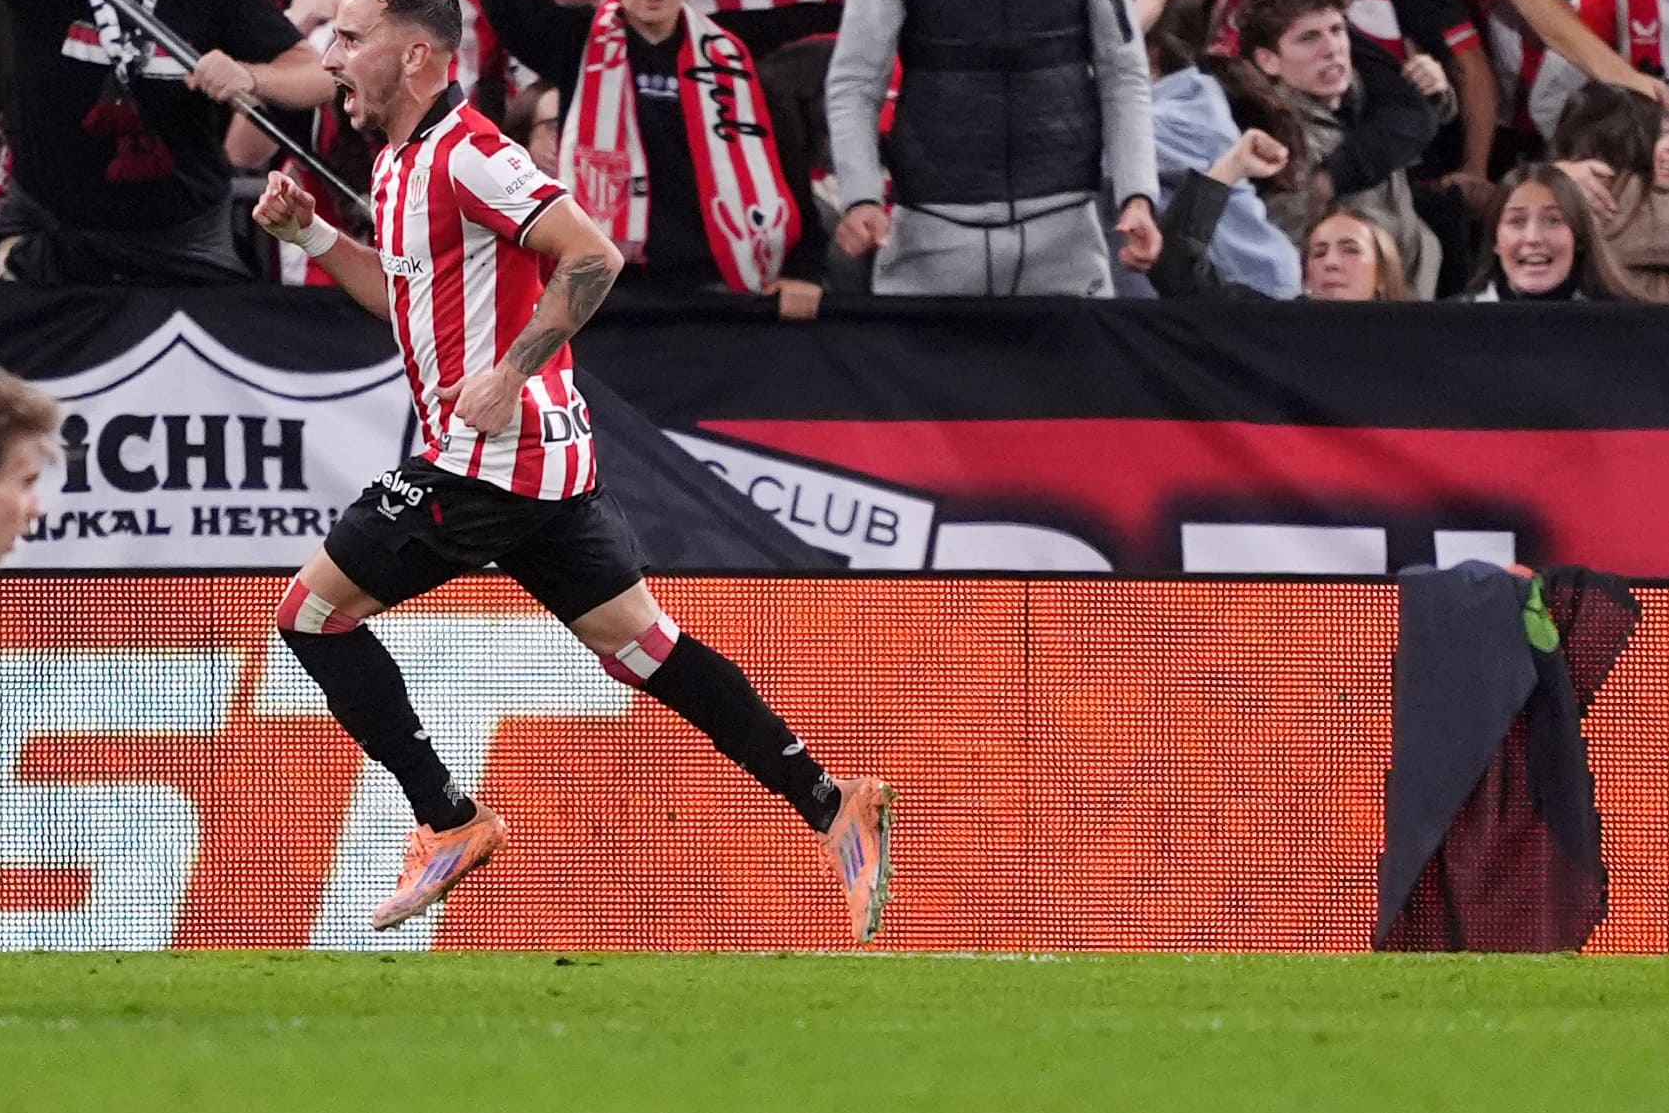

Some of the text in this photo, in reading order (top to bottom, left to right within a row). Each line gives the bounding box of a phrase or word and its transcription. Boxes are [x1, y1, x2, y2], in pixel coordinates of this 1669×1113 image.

[60, 414, 308, 493] iCHH
[22, 509, 173, 543] USKAL
[749, 476, 900, 547] CLUB
